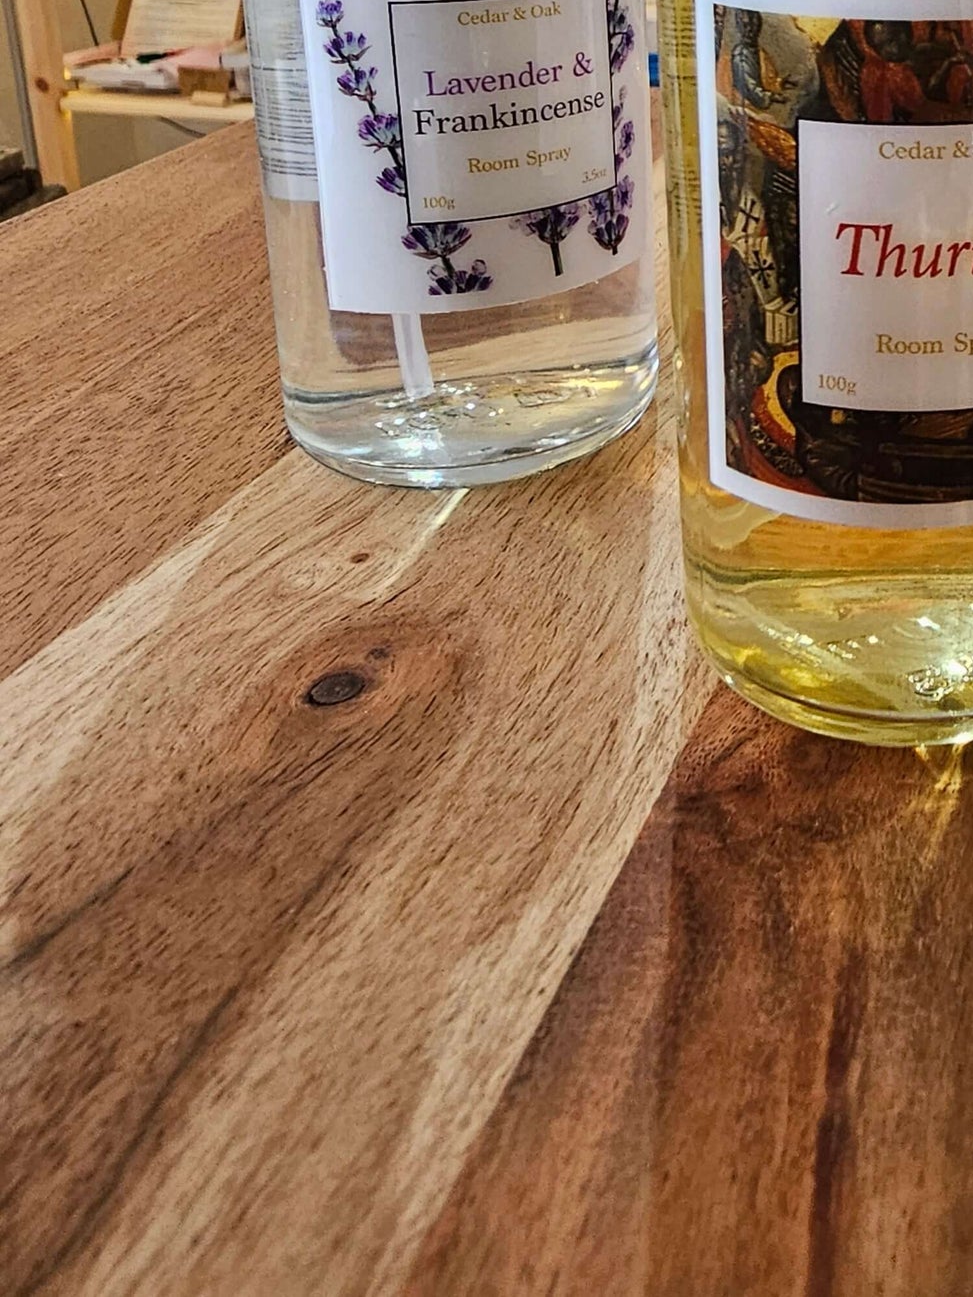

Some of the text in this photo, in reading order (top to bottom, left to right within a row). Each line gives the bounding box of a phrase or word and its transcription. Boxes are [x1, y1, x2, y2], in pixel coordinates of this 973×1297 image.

[456, 1, 562, 26] Cedar & Oak
[423, 51, 594, 98] Lavender &
[413, 90, 607, 136] Frankincense
[467, 145, 572, 174] Room Spray
[878, 140, 946, 160] Cedar
[951, 140, 972, 159] &
[422, 196, 457, 210] 100g
[875, 333, 945, 355] Room
[817, 373, 857, 395] 100g
